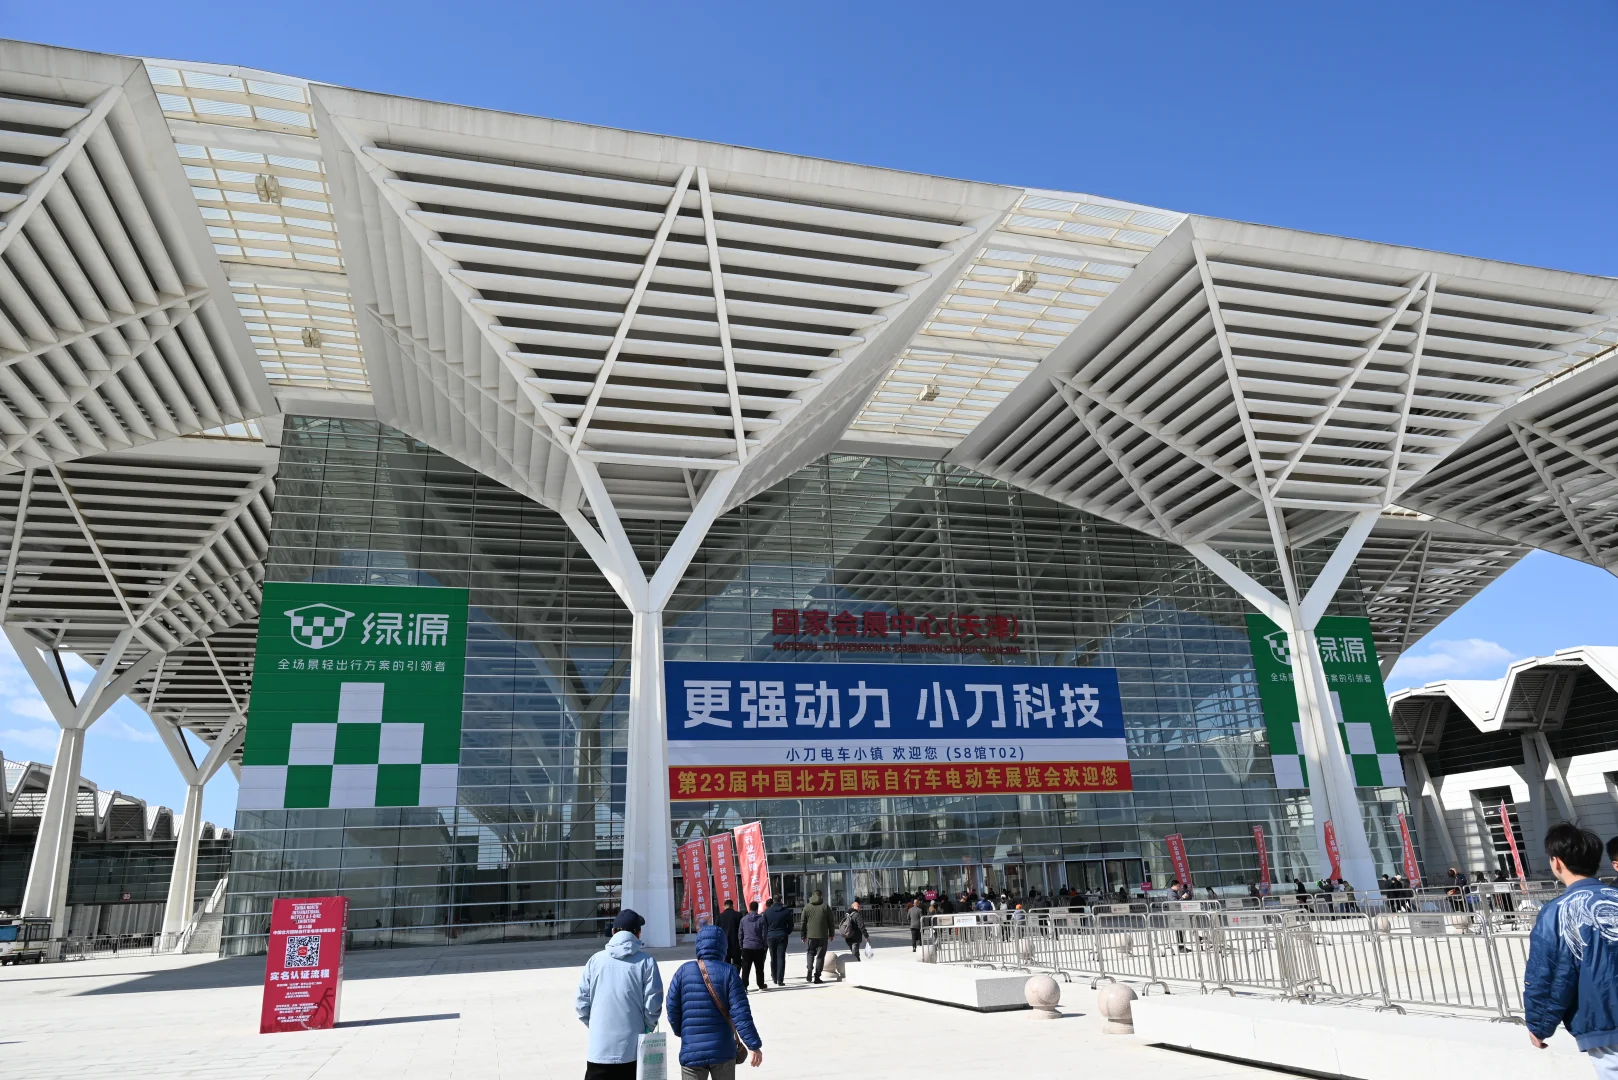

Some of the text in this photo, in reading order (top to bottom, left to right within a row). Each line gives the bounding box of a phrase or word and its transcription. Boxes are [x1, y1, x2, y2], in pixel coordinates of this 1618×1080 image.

[360, 612, 450, 647] 绿源
[772, 608, 1019, 639] 国家会展中心(天津)
[773, 641, 821, 652] NATIONAL
[823, 642, 882, 653] CONVENTION
[883, 644, 892, 653] &
[893, 643, 943, 654] EXHIBITION
[277, 658, 446, 672] 全场景轻出行方案的引领者
[683, 680, 1104, 729] 更强动力 小刀科技
[786, 746, 1025, 762] 小刀电车小镇 欢迎您 (S8馆T02)
[677, 765, 1119, 795] 第23届中国北方国际自行车电动车展览会欢迎您
[270, 969, 330, 981] 实名认证流程
